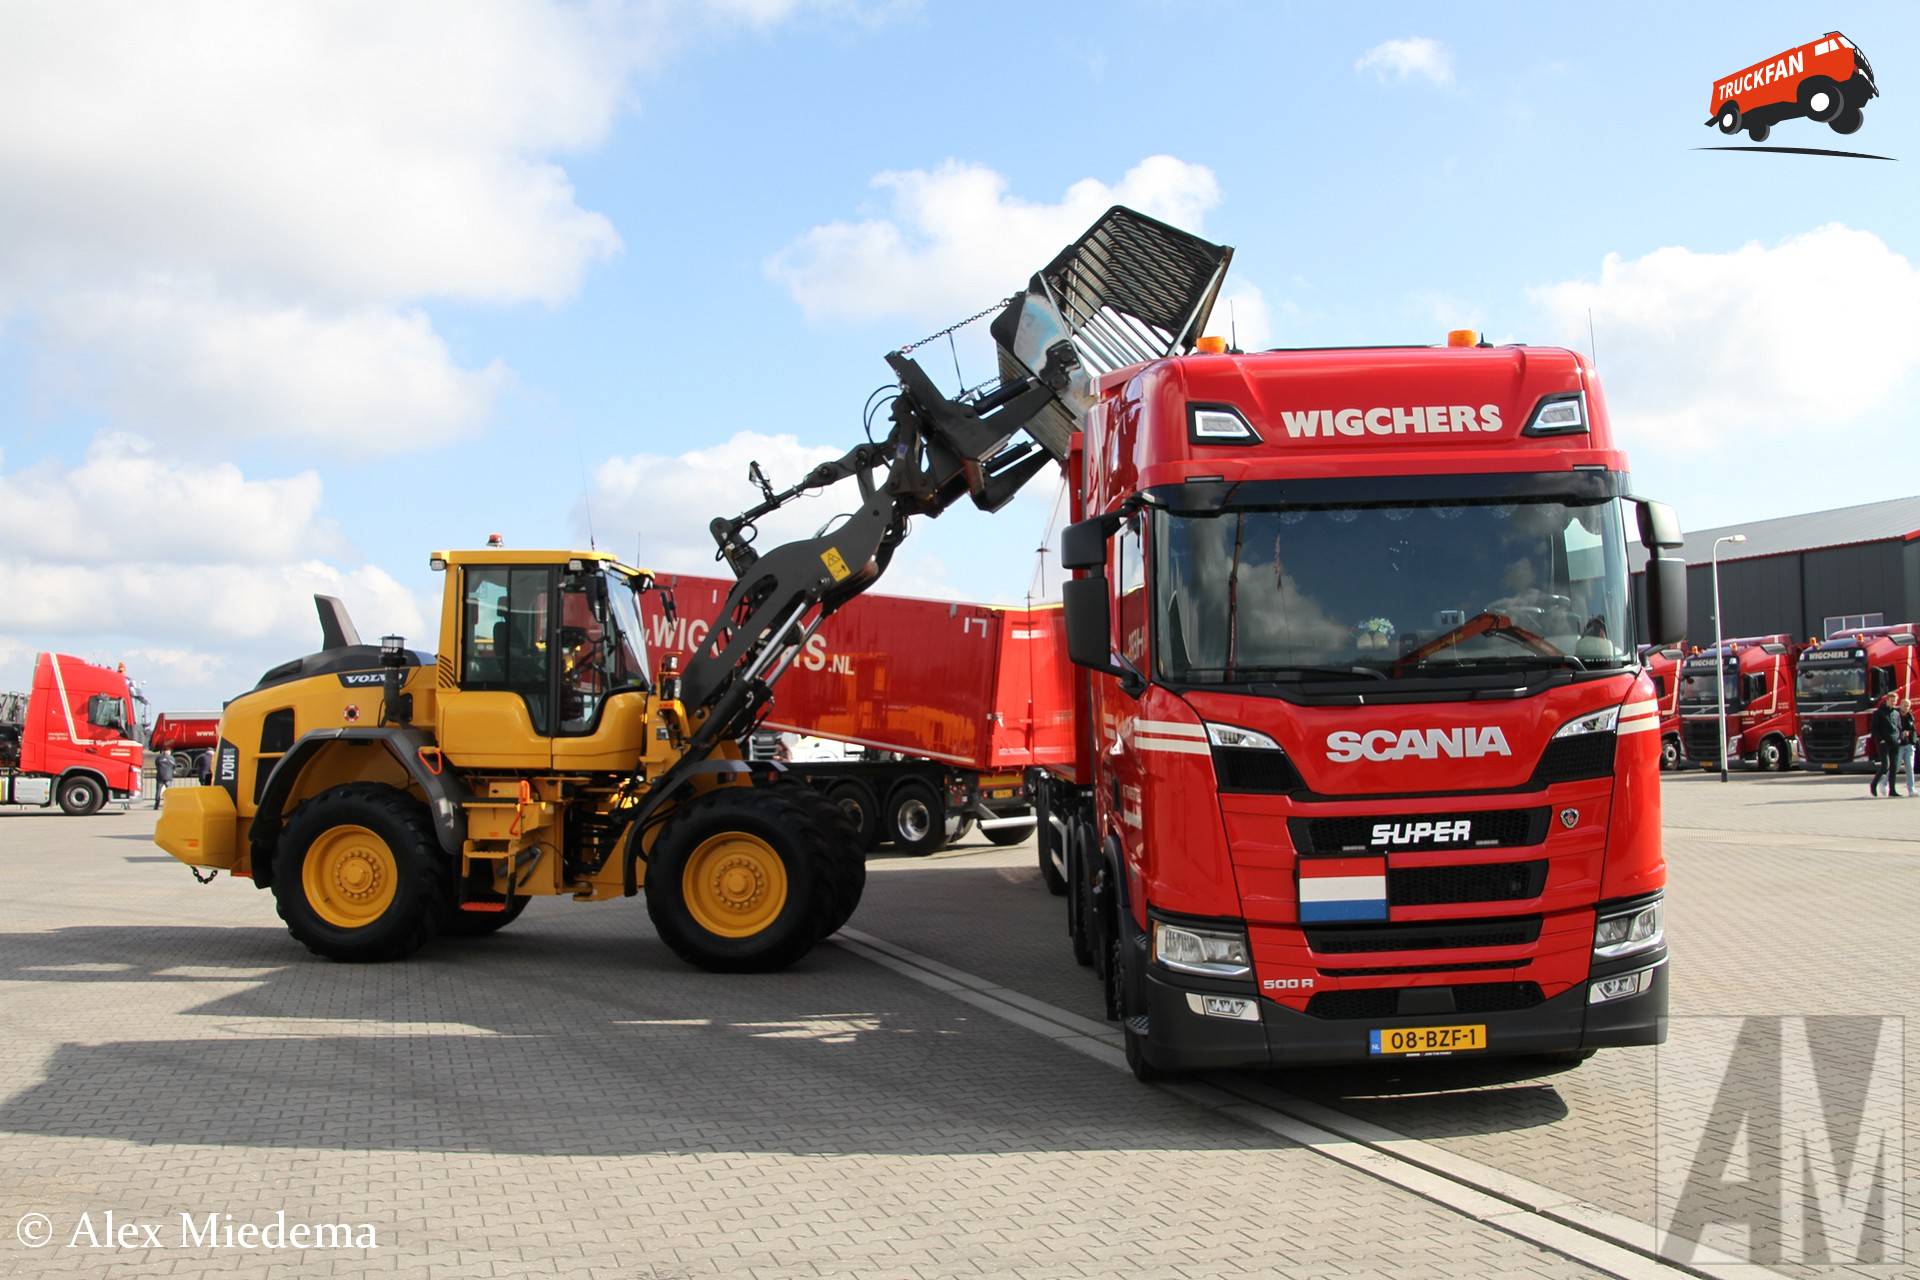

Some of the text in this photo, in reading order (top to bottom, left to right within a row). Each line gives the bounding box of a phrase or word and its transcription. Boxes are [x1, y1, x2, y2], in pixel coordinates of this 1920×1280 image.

[1281, 404, 1503, 438] WIGCHERS
[1809, 651, 1850, 661] WIGCHERS
[1326, 726, 1512, 764] SCANIA
[221, 754, 236, 780] L70H
[1371, 820, 1472, 845] SUPER
[1263, 978, 1314, 989] 500 R
[1371, 1028, 1475, 1051] NL 08-BZF-1
